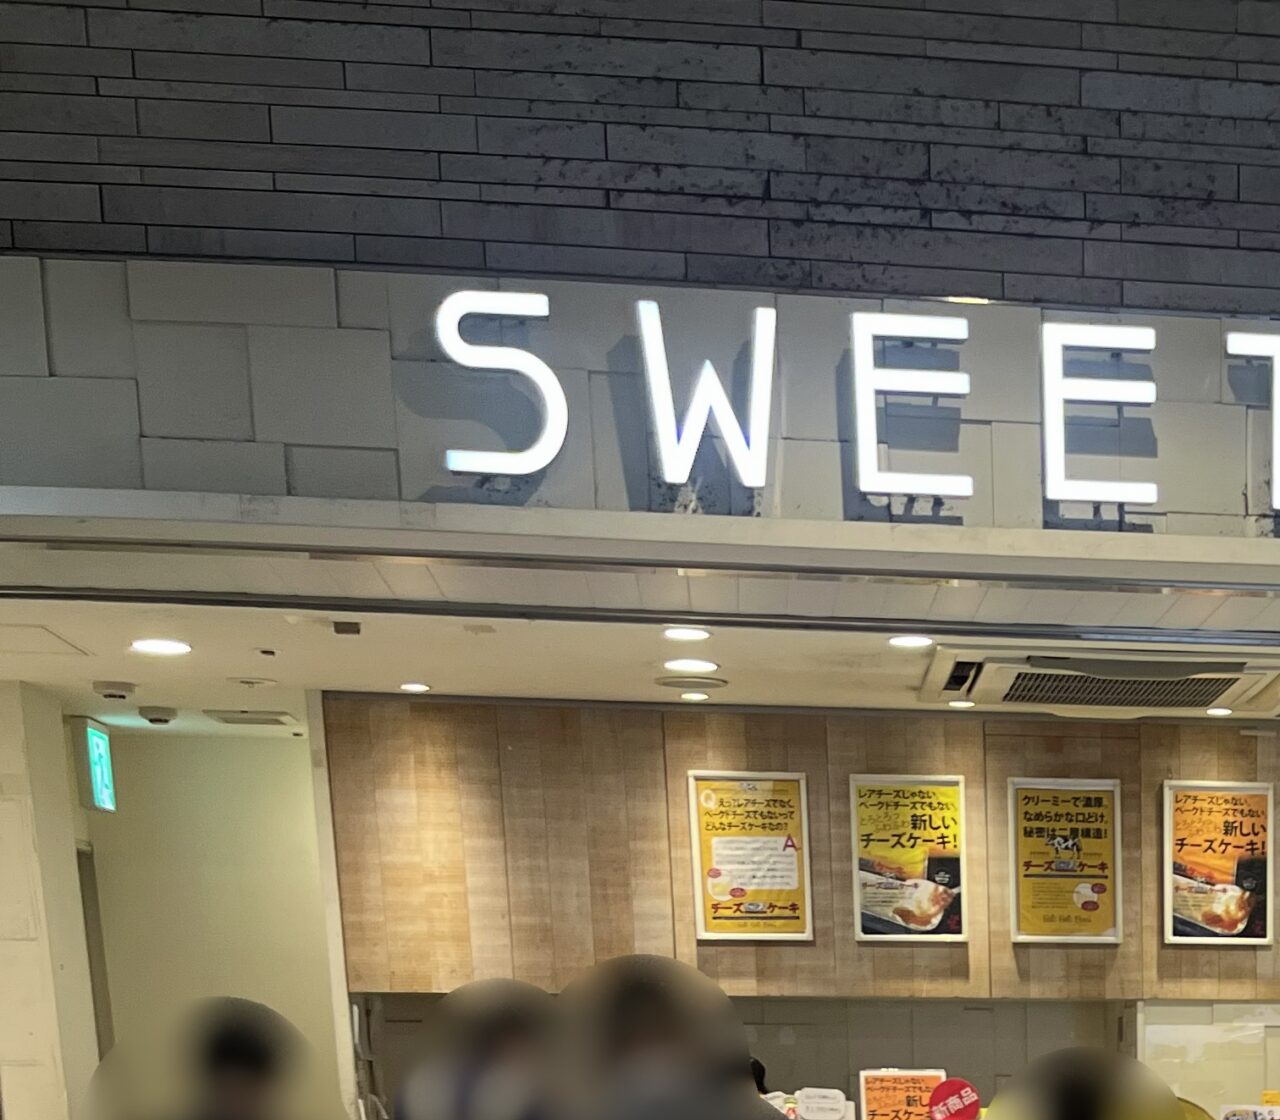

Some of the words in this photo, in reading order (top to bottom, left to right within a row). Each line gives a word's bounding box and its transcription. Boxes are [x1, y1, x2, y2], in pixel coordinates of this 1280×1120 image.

[910, 813, 957, 831] 新しい
[1223, 820, 1267, 837] 新しい
[860, 832, 957, 849] チーズケーキ!
[1175, 838, 1266, 856] チーズケーキ!
[931, 1086, 979, 1120] 新商品
